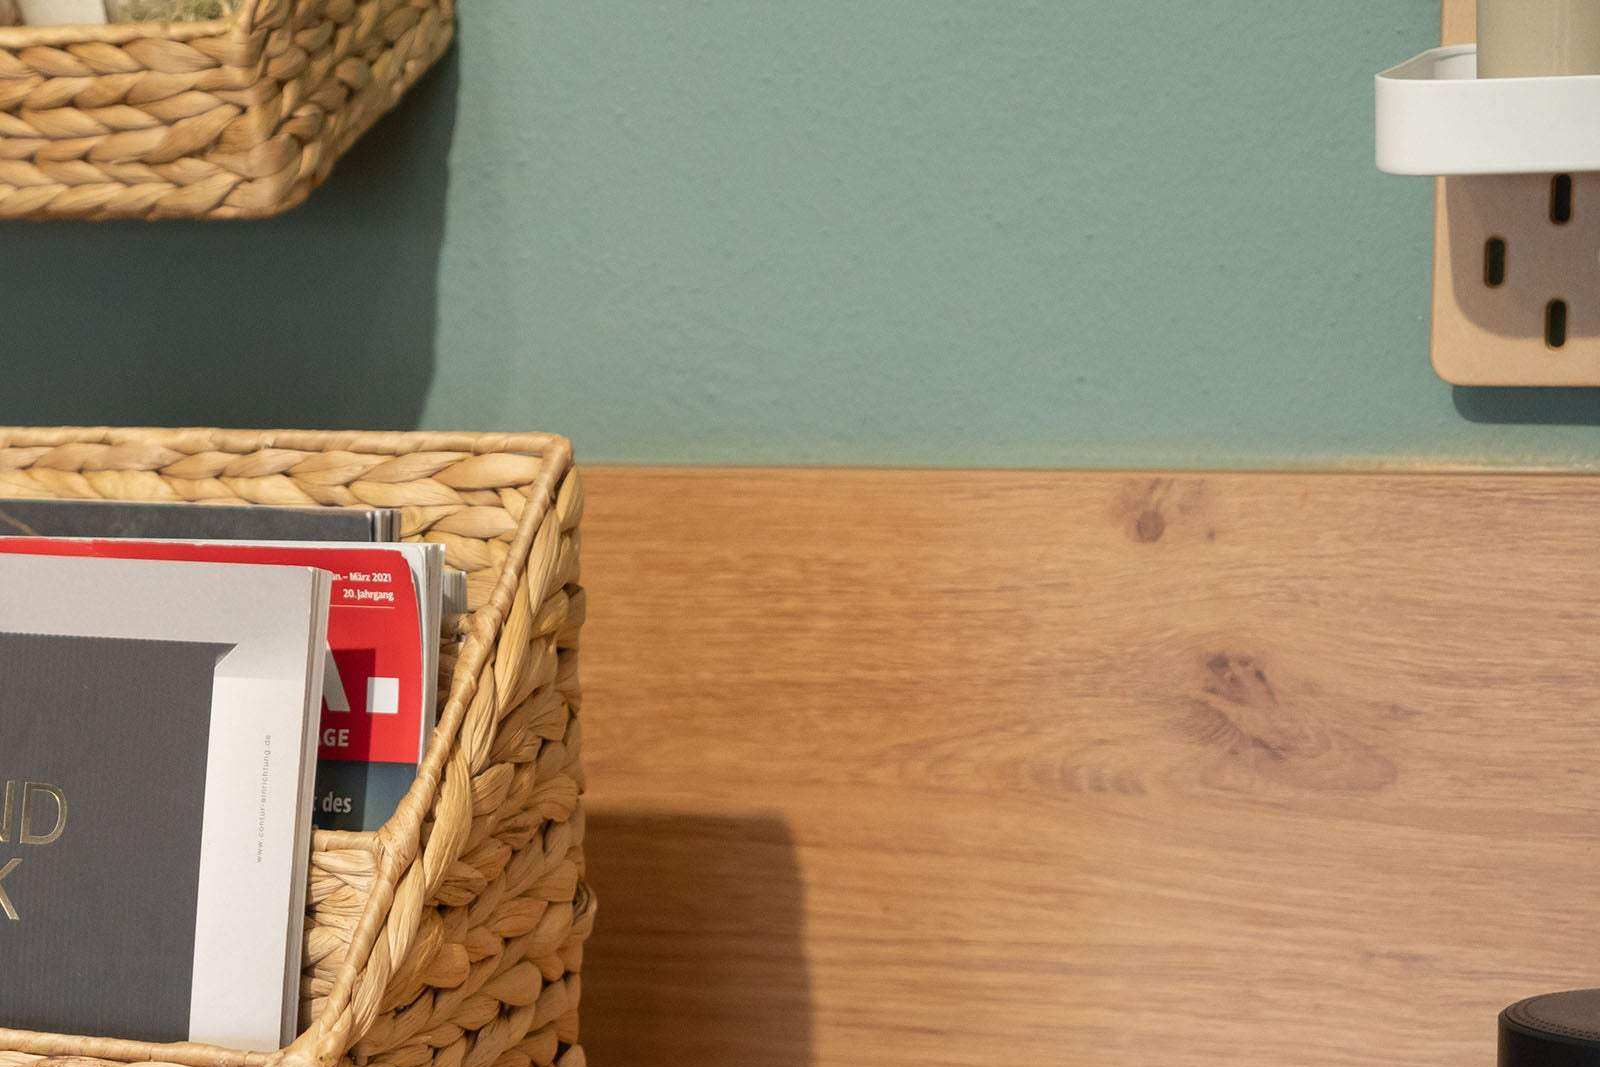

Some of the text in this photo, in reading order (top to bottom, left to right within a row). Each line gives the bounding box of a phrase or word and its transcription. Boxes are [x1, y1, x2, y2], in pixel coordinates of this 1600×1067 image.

[331, 572, 343, 582] an.
[349, 572, 371, 582] März
[372, 572, 392, 583] 2021
[343, 588, 395, 602] 20. Jahrgang
[318, 727, 350, 748] GE
[256, 734, 272, 863] www.contur-einrichtung.de
[321, 791, 352, 814] des
